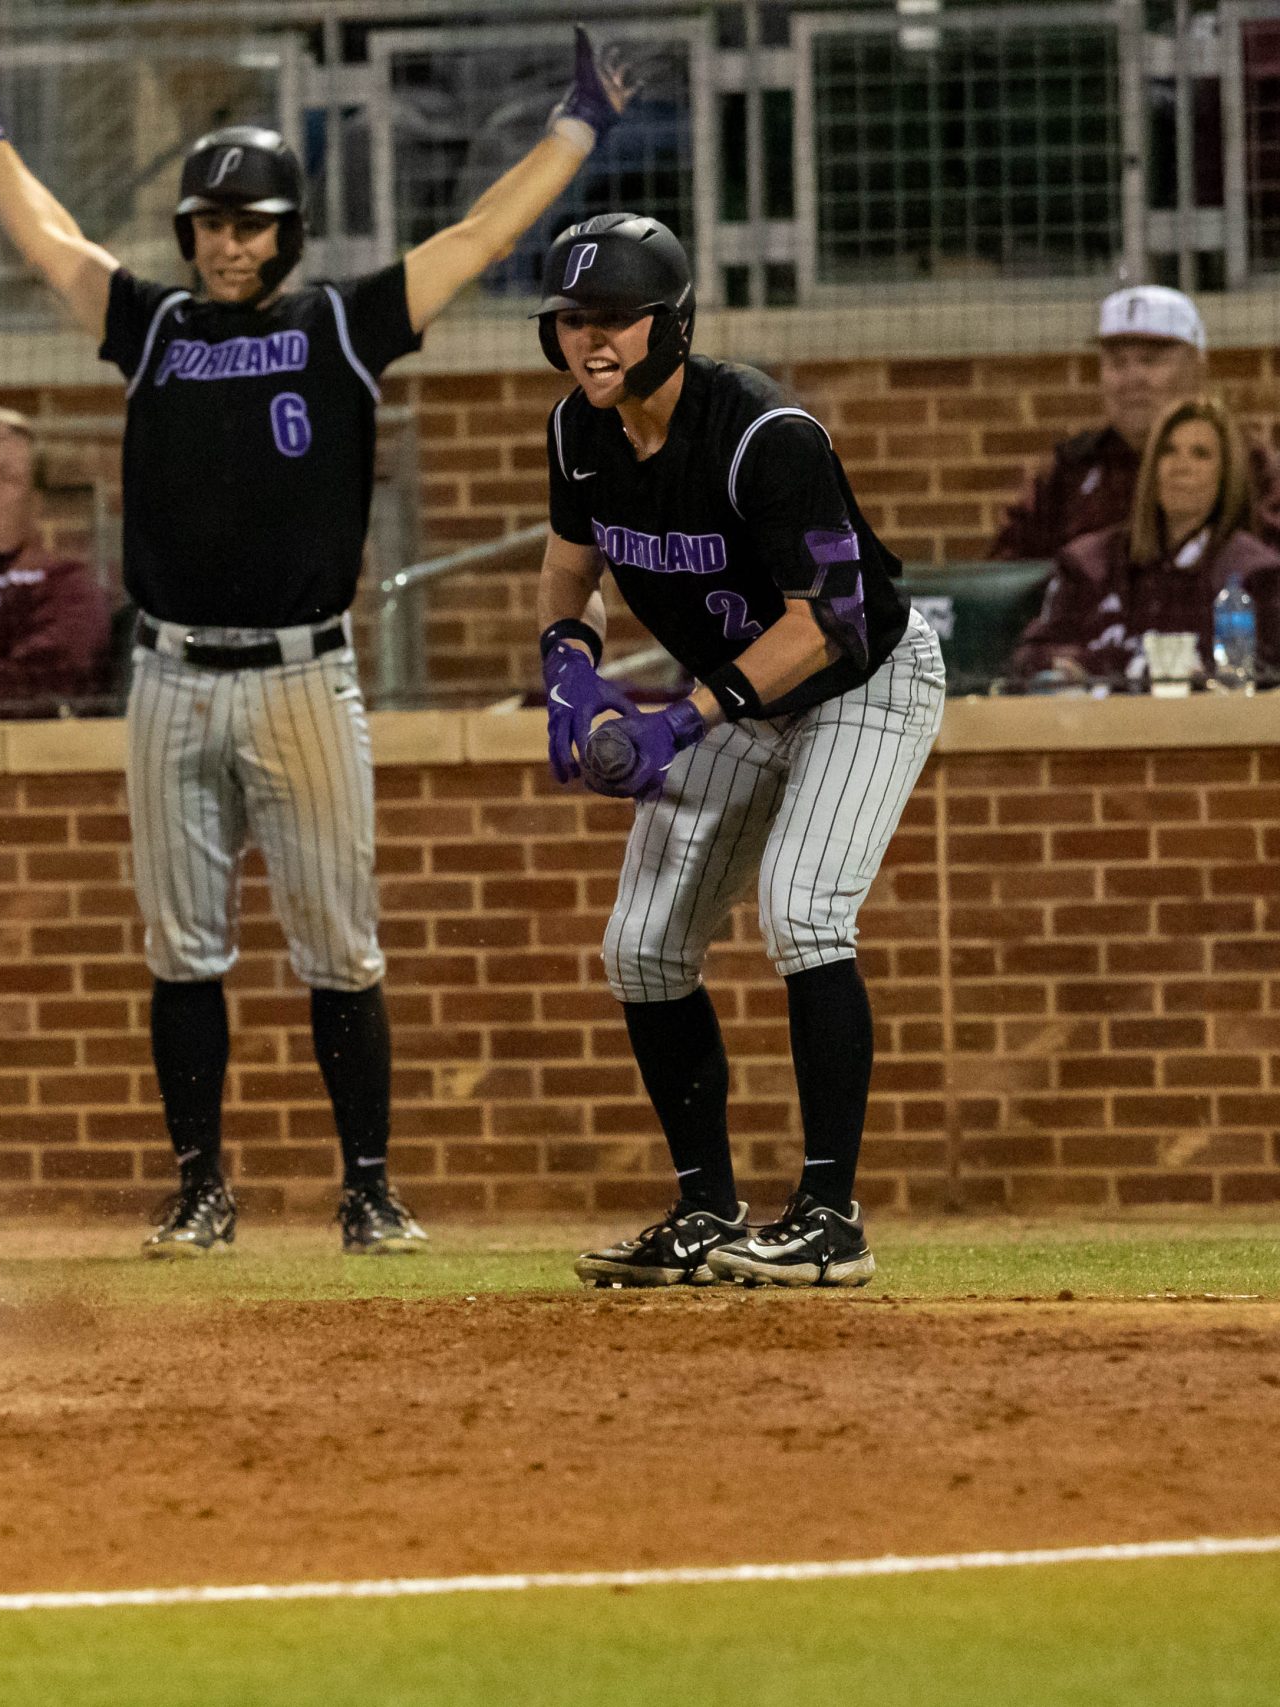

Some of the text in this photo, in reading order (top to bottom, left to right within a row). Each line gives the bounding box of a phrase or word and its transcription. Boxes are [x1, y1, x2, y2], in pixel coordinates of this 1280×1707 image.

[562, 242, 598, 290] P
[153, 329, 310, 387] PORTLAND
[270, 391, 313, 458] 6
[591, 516, 727, 574] PORTLAND
[705, 590, 764, 640] 2
